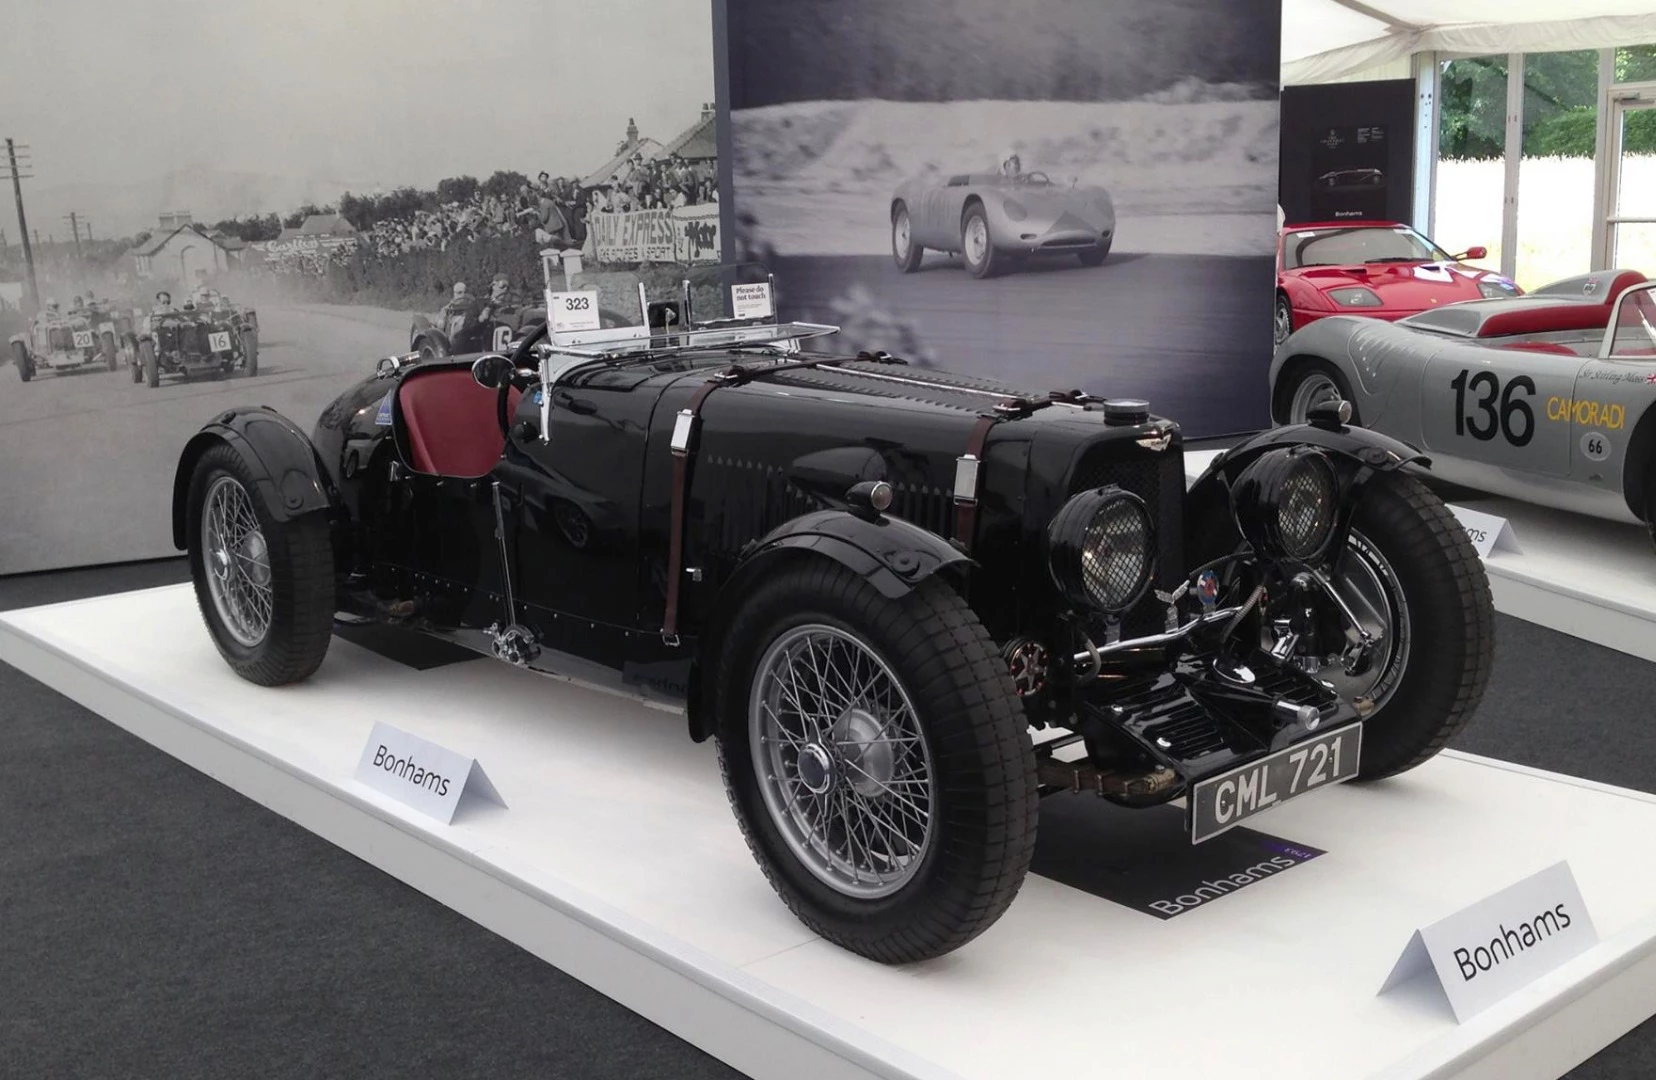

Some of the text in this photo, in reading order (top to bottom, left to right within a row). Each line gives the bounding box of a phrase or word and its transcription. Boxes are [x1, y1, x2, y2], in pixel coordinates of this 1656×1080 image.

[622, 209, 673, 245] EXPRESS
[566, 297, 589, 310] 323
[756, 285, 764, 293] do
[75, 332, 91, 345] 20
[212, 335, 227, 349] 16
[1451, 369, 1536, 447] 136
[1547, 396, 1625, 429] CAMORADI
[1588, 439, 1603, 454] 66
[373, 744, 451, 796] Bonhams
[1214, 736, 1342, 824] CML 721
[1148, 856, 1296, 915] Bonhams
[1453, 904, 1571, 981] Bonhams
